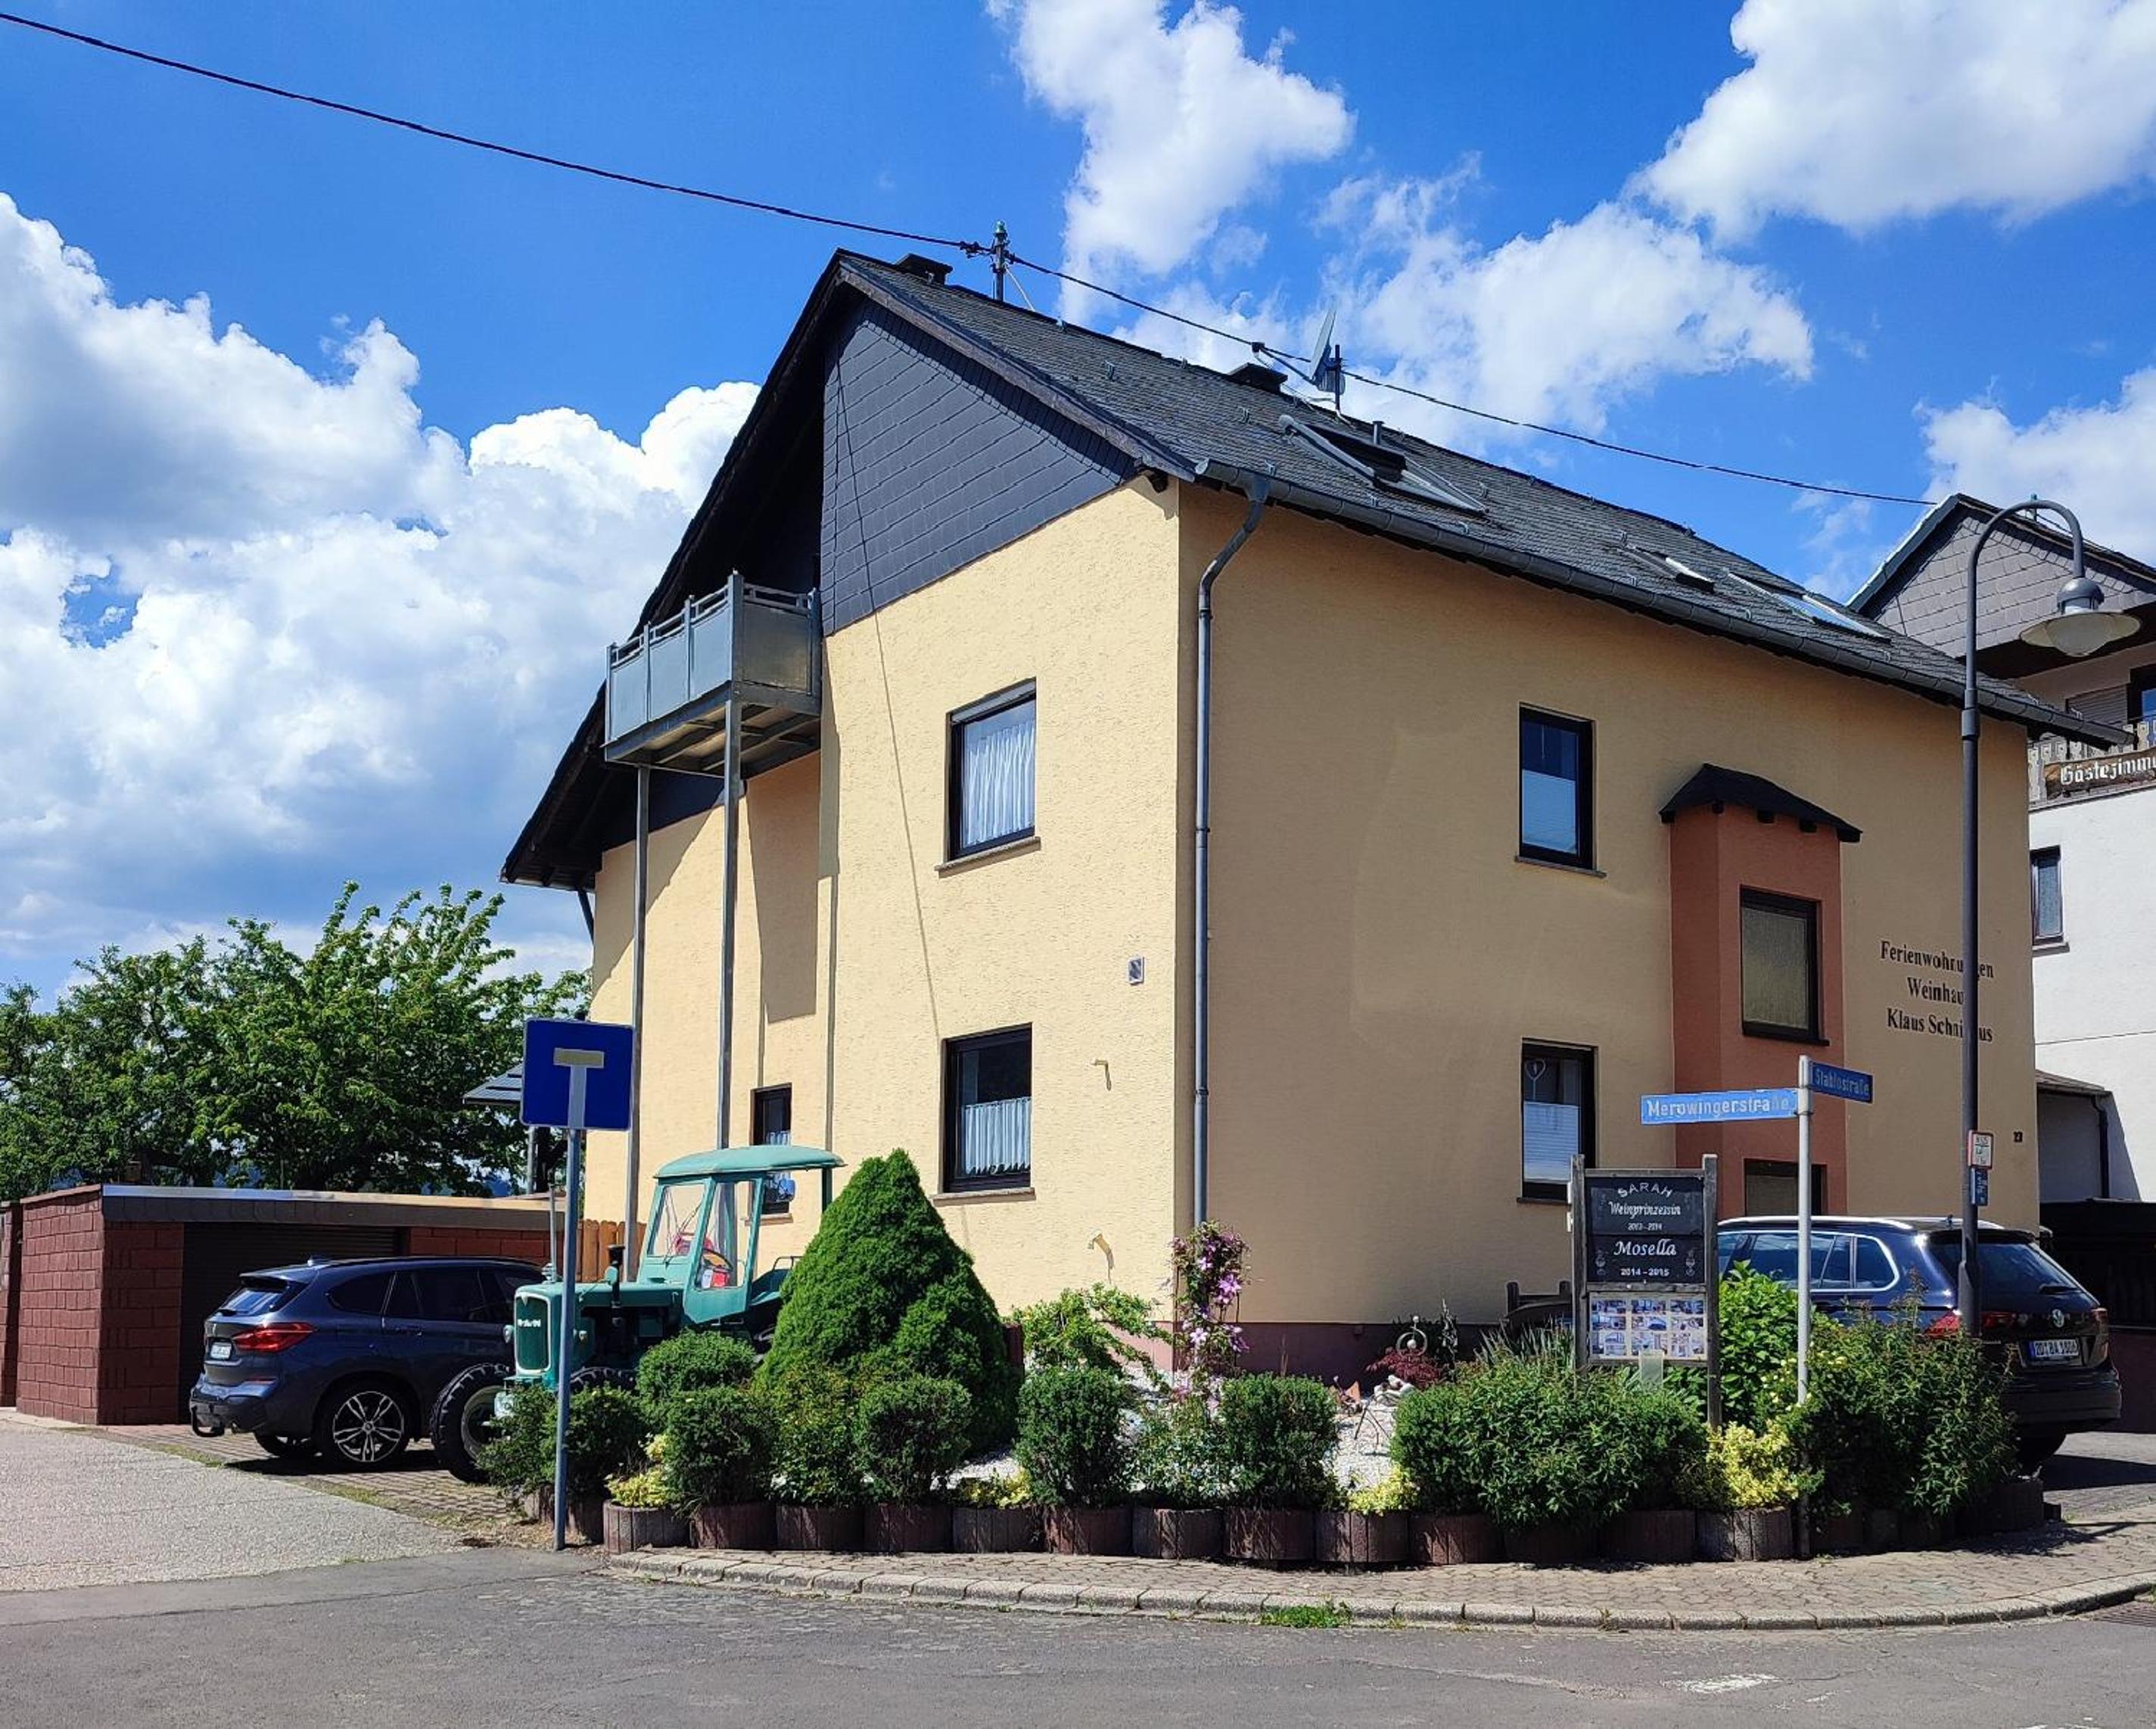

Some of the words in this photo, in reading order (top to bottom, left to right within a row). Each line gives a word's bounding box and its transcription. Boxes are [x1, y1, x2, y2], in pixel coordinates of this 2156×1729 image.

[1881, 940, 1994, 981] Ferienwohnuen
[1907, 976, 1965, 1006] Weinhau
[1887, 1007, 1925, 1033] Klaus
[1928, 1014, 1993, 1042] Schnius
[1617, 1182, 1673, 1198] SARAH
[1608, 1201, 1682, 1220] Weinprinzessin
[1613, 1238, 1677, 1256] Mosella
